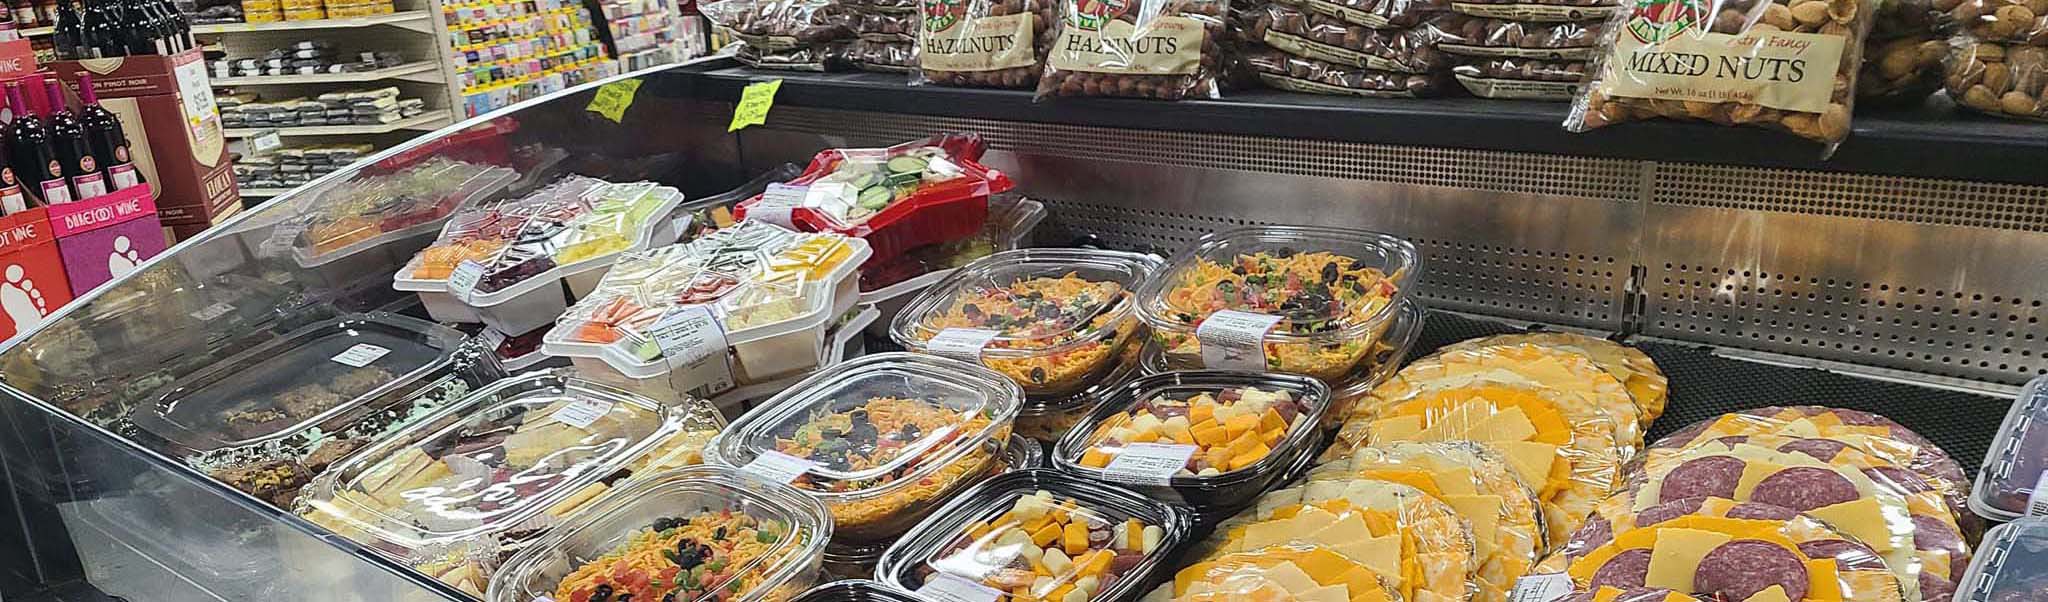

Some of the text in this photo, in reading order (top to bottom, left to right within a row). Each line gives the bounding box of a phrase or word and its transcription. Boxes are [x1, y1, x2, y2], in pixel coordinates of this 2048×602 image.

[1065, 34, 1177, 55] HAZNUTS
[1768, 35, 1811, 55] Fancy
[1624, 51, 1709, 77] MIXED
[1717, 54, 1807, 83] NUTS
[104, 80, 126, 88] PINOT
[128, 78, 147, 86] NOIR
[1687, 88, 1697, 97] 16
[64, 198, 141, 229] BAREFOOT WINE
[11, 224, 37, 242] WINE
